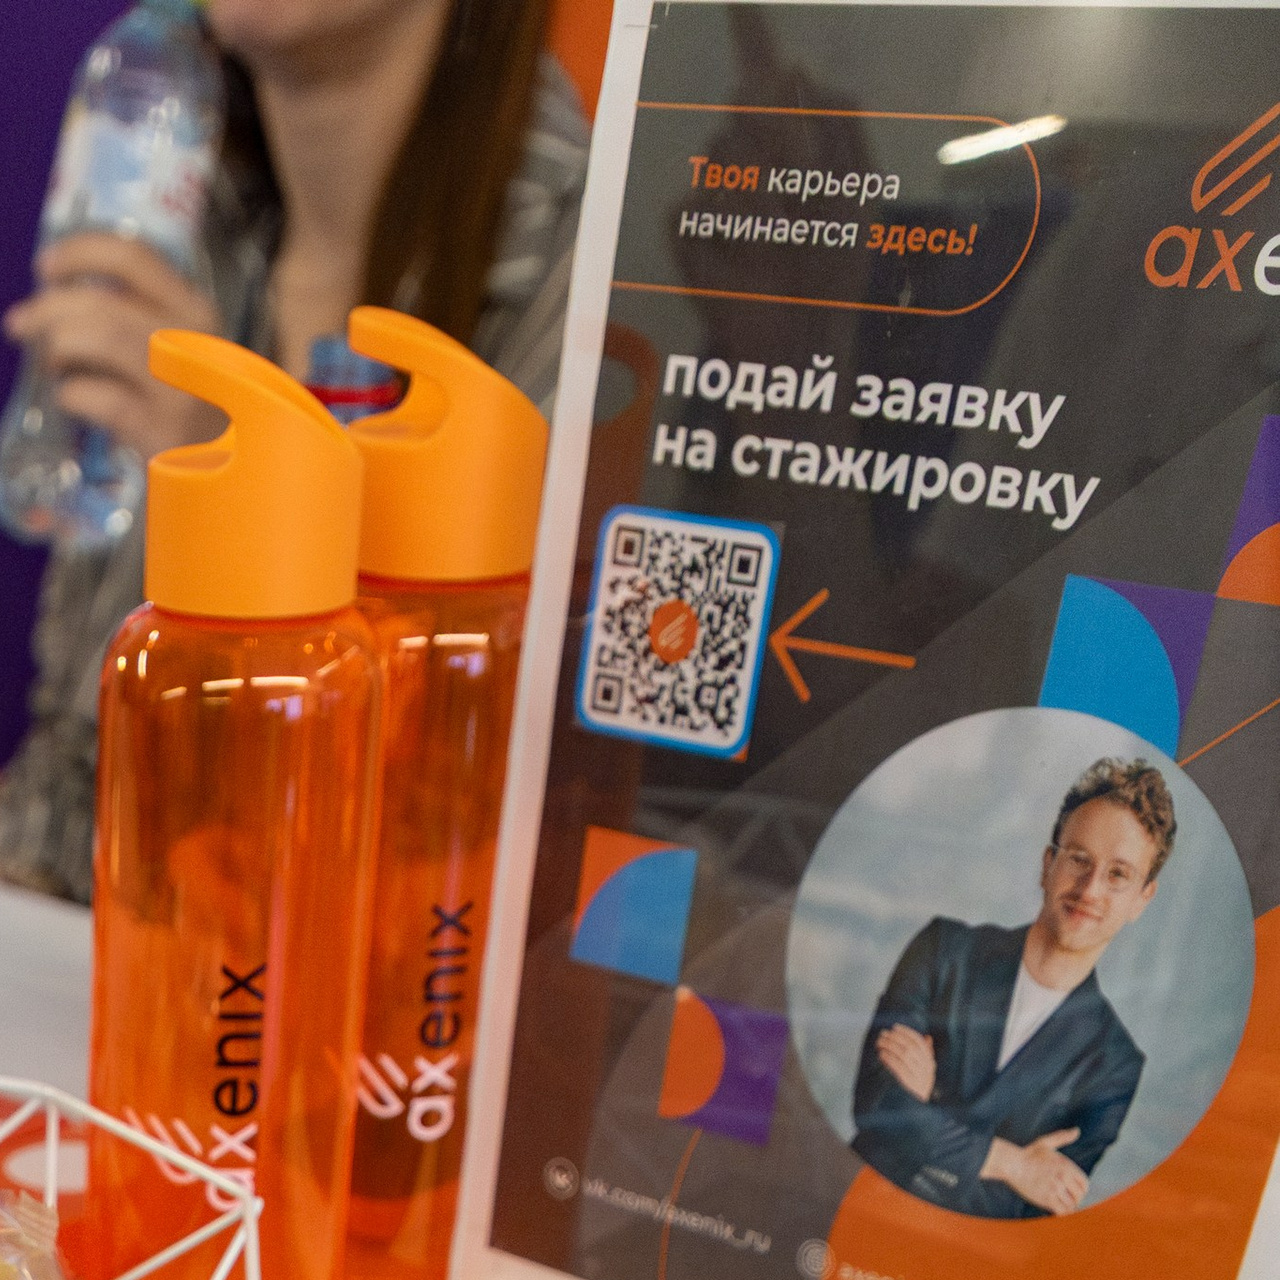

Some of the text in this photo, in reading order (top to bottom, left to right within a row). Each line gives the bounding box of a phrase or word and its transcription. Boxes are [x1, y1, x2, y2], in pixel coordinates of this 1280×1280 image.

[687, 156, 901, 205] Твоя карьера
[679, 209, 978, 257] начинается здесь!
[662, 354, 1065, 450] подай заявку
[652, 423, 1100, 531] на стажировку
[406, 900, 473, 1143] axenix
